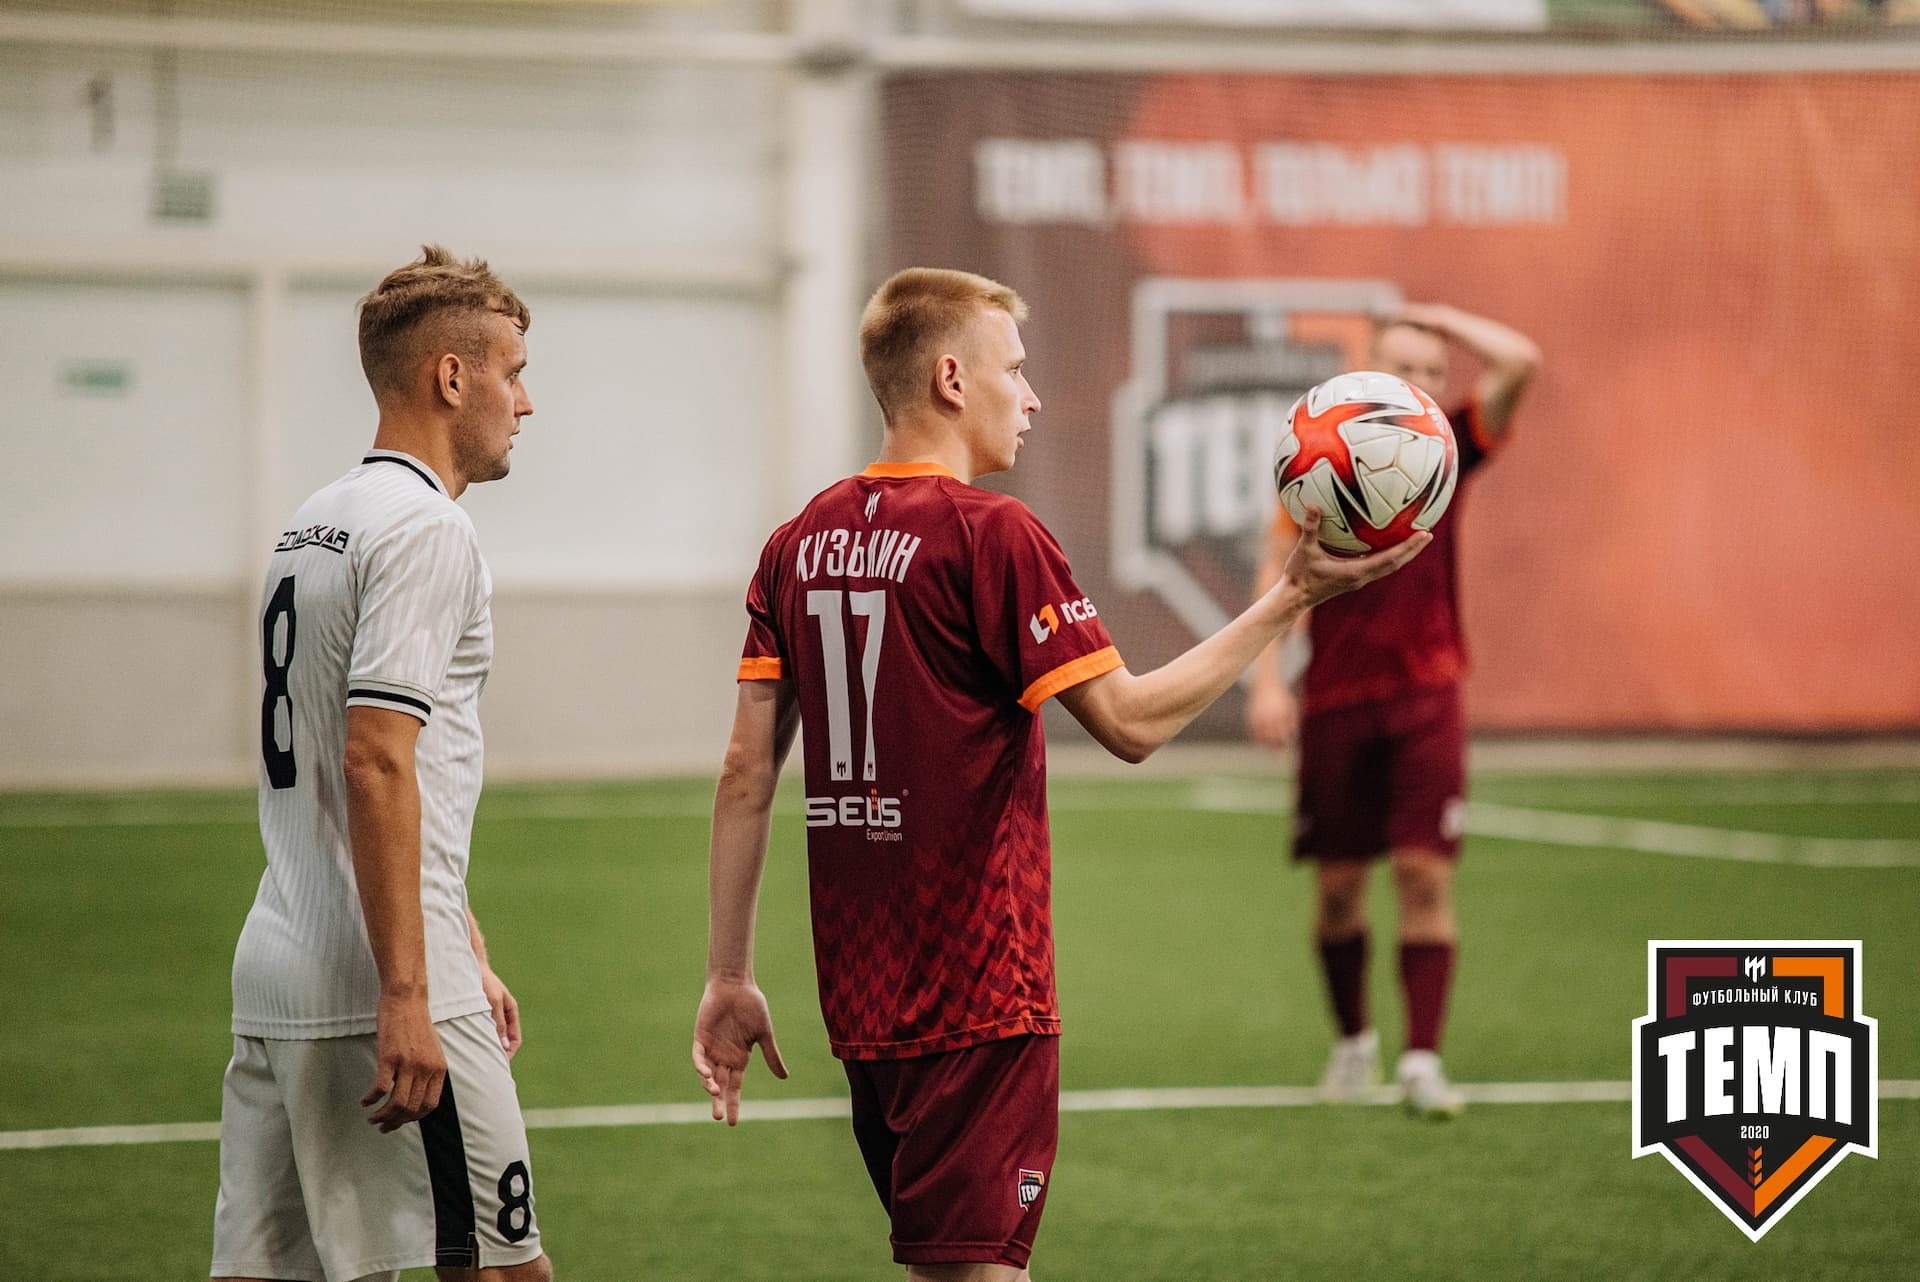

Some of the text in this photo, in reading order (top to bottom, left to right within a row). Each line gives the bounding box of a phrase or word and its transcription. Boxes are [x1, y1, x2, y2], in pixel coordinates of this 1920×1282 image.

[1060, 597, 1098, 625] ПСБ
[262, 575, 297, 789] 8
[806, 589, 887, 781] 17
[496, 1160, 532, 1244] 8
